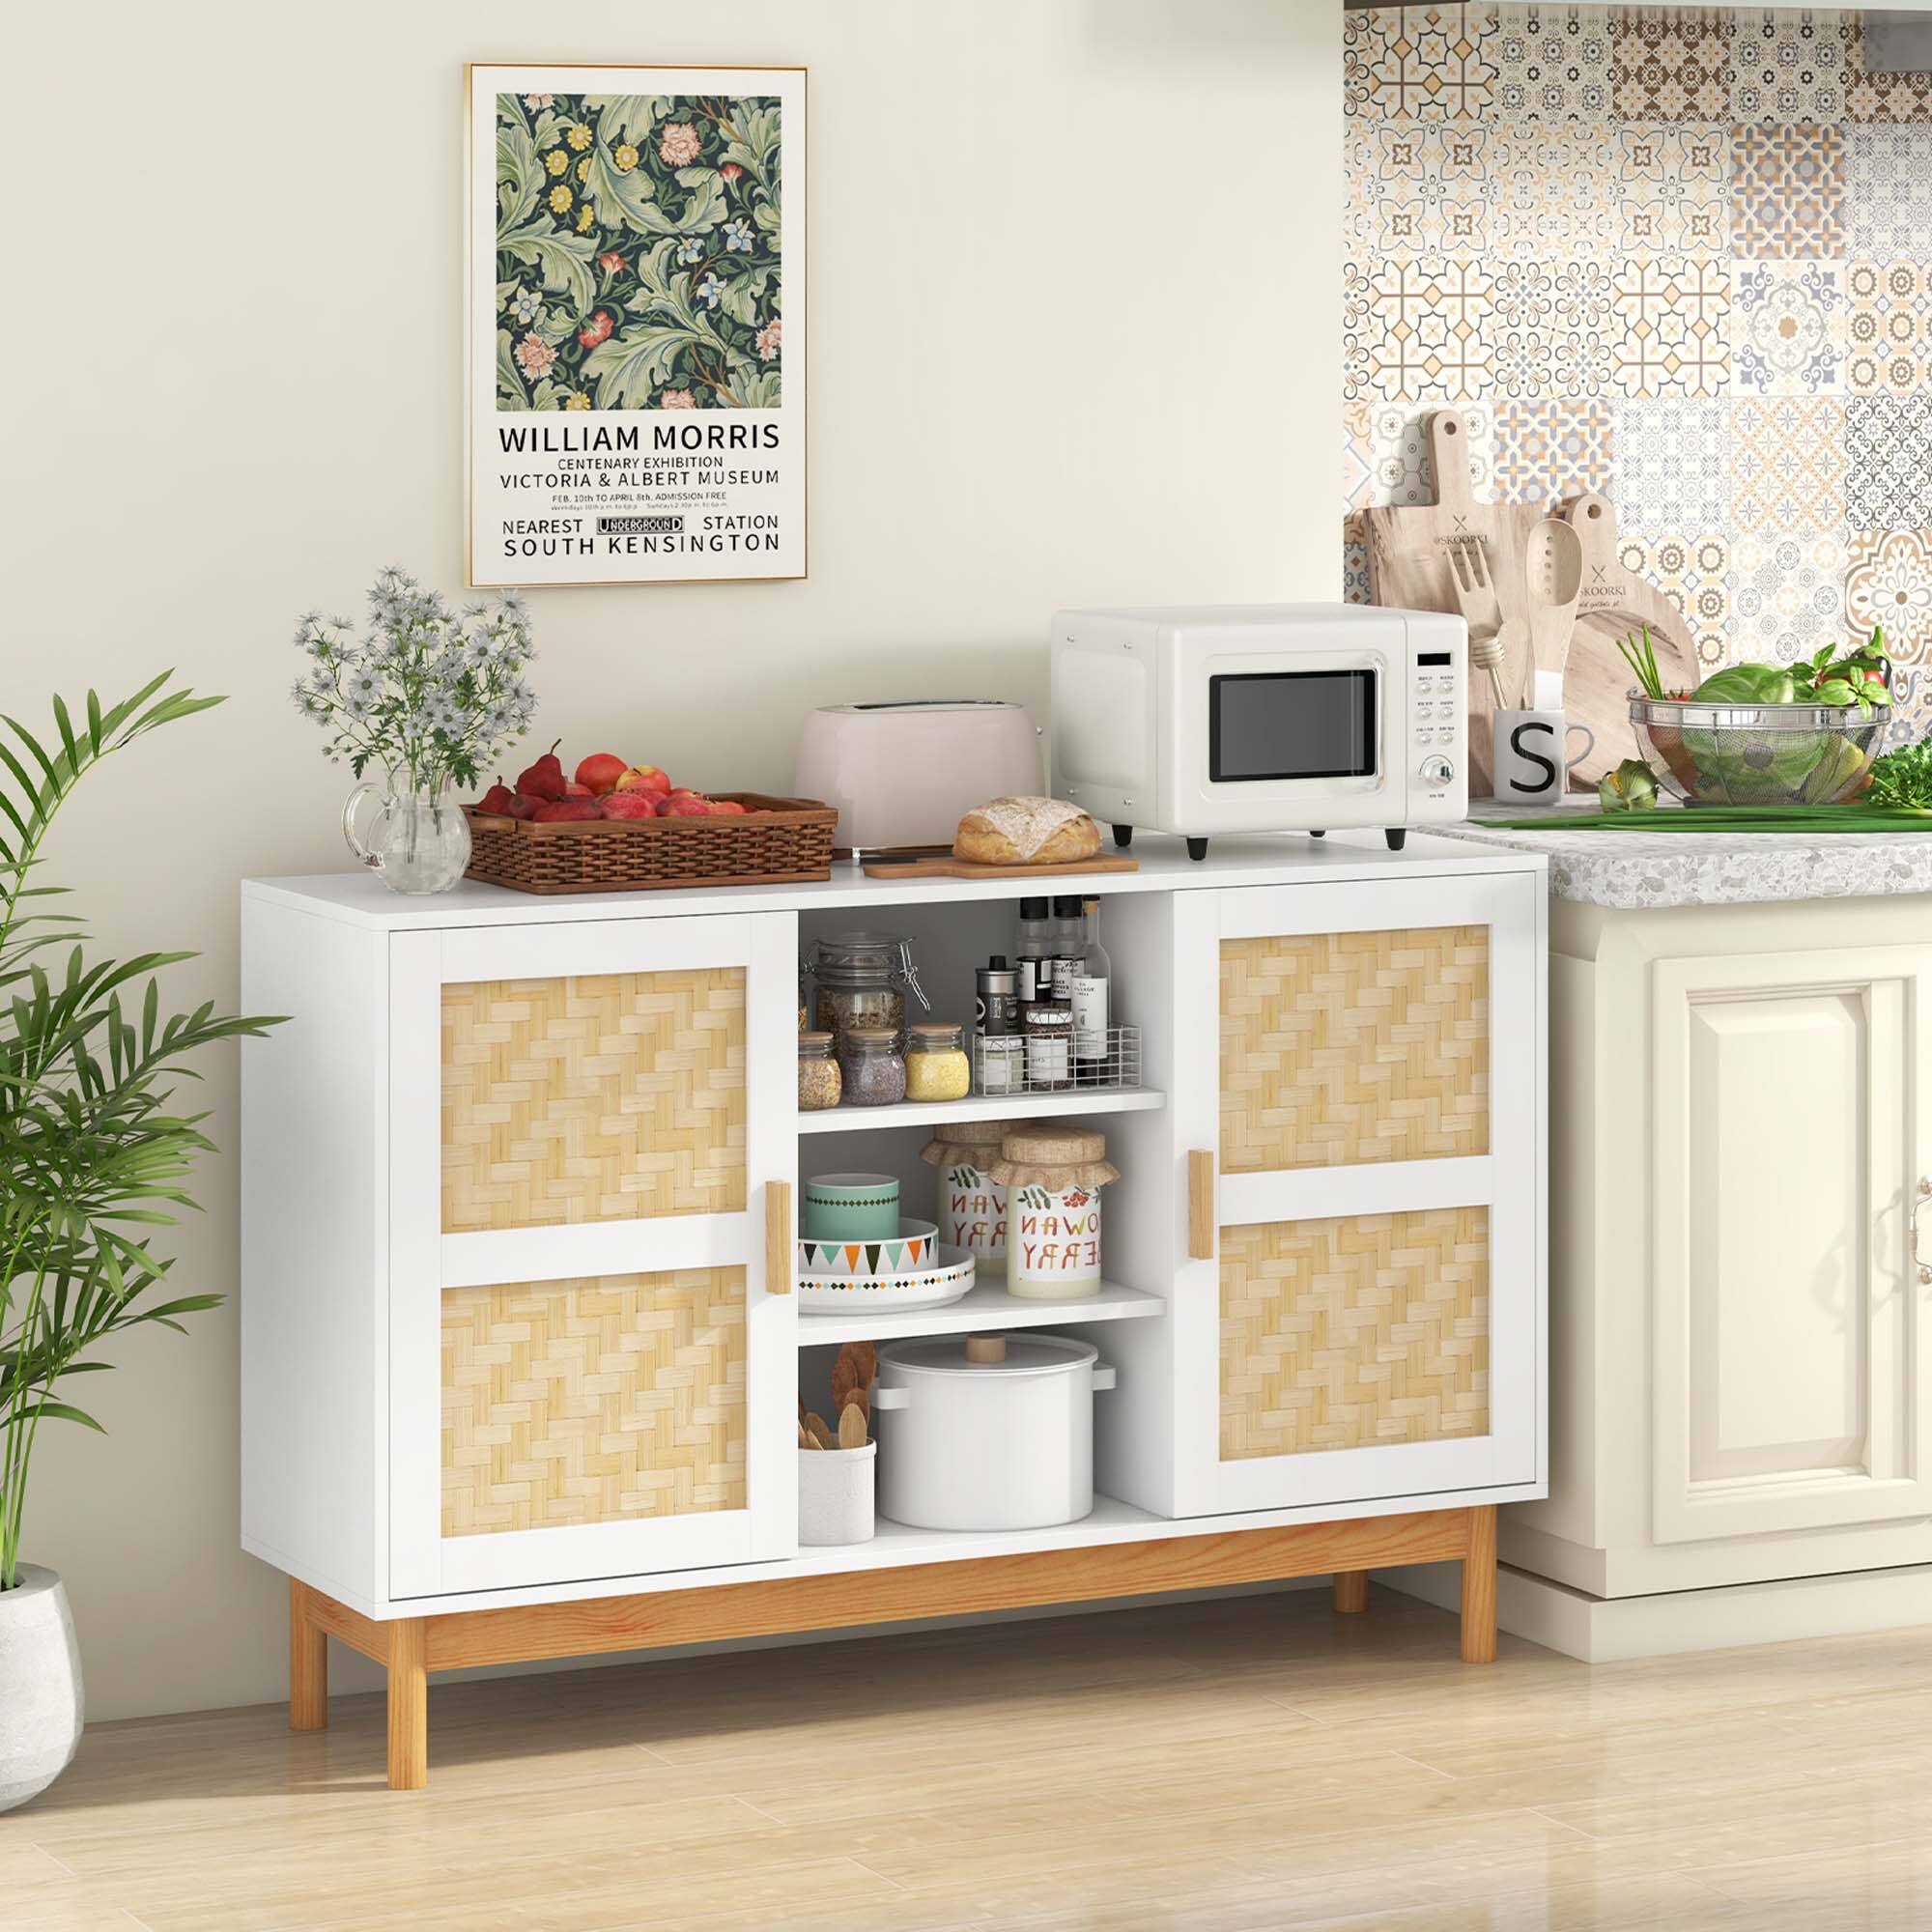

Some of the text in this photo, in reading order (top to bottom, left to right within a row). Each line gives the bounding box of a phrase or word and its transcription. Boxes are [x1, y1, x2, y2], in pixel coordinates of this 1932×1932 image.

[498, 423, 780, 453] WILLIAM MORRIS
[557, 455, 724, 470] CENTENARY EXHIBITION
[499, 469, 780, 489] VICTORIA & ALBERT MUSEUM
[595, 494, 609, 502] TO
[609, 493, 635, 502] APRIL
[655, 492, 704, 501] ADMISSION
[705, 491, 727, 500] FREE
[502, 519, 583, 535] NEAREST
[702, 514, 780, 530] STATION
[503, 533, 780, 557] SOUTH KENSINGTON
[1509, 722, 1556, 793] S
